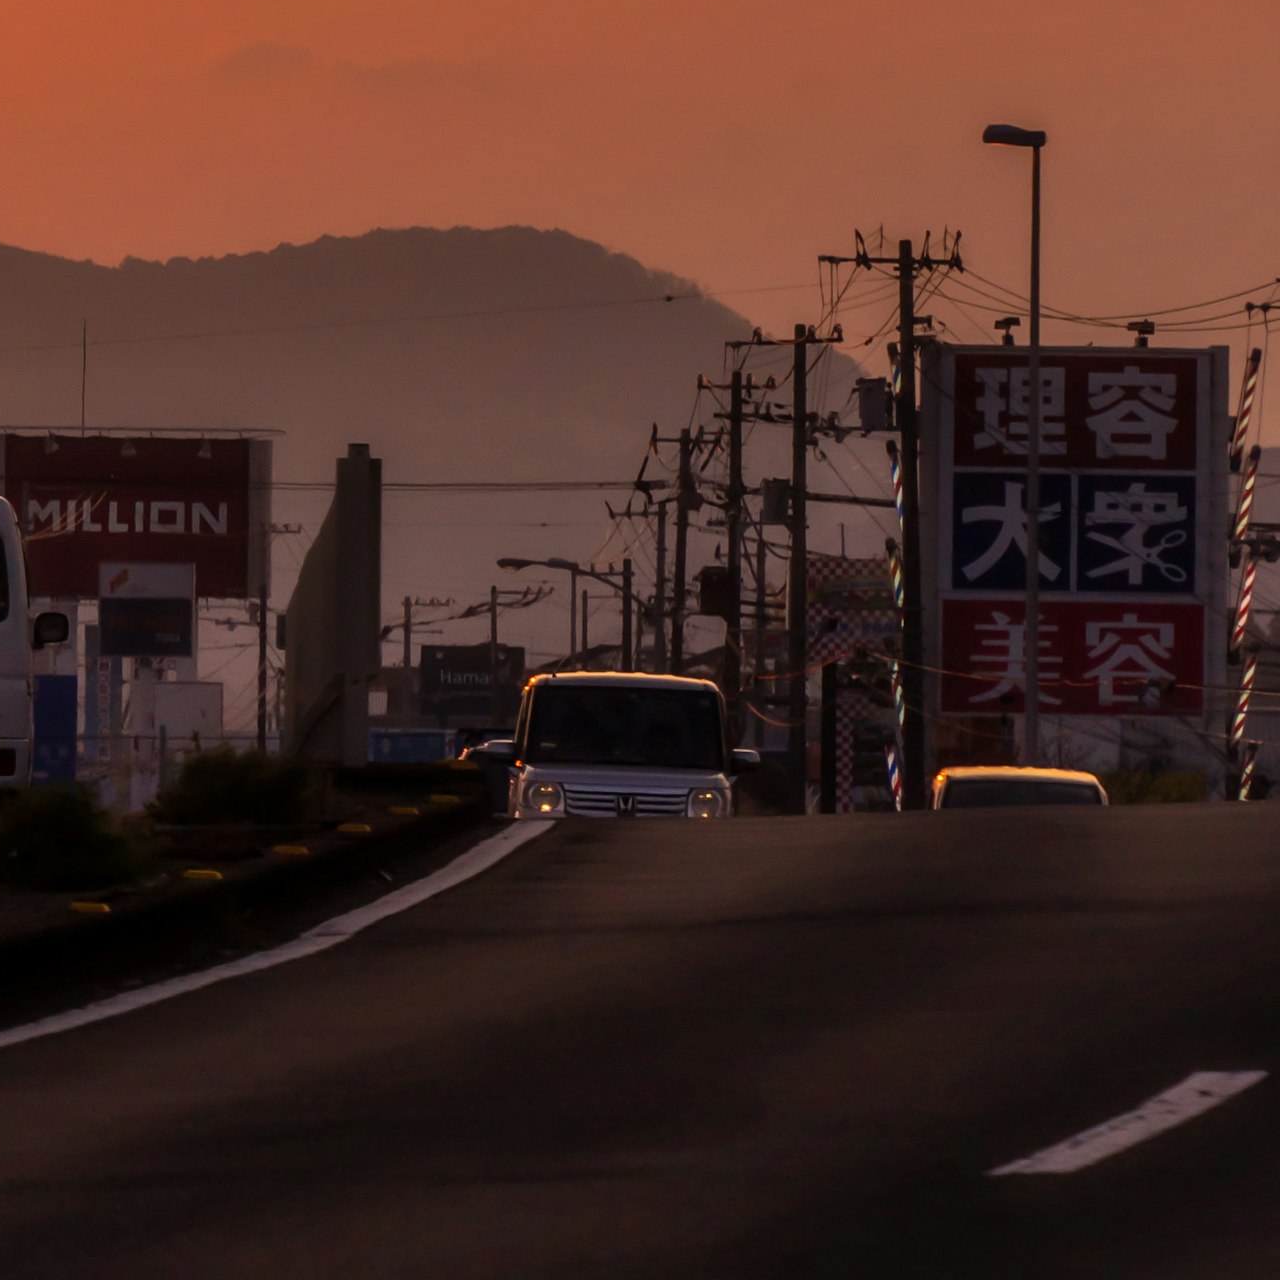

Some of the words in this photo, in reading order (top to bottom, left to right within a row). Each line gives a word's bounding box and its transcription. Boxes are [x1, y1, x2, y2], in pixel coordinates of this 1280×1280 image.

[973, 366, 1179, 461] 理容
[28, 498, 228, 535] MILLION
[968, 610, 1177, 706] 美容
